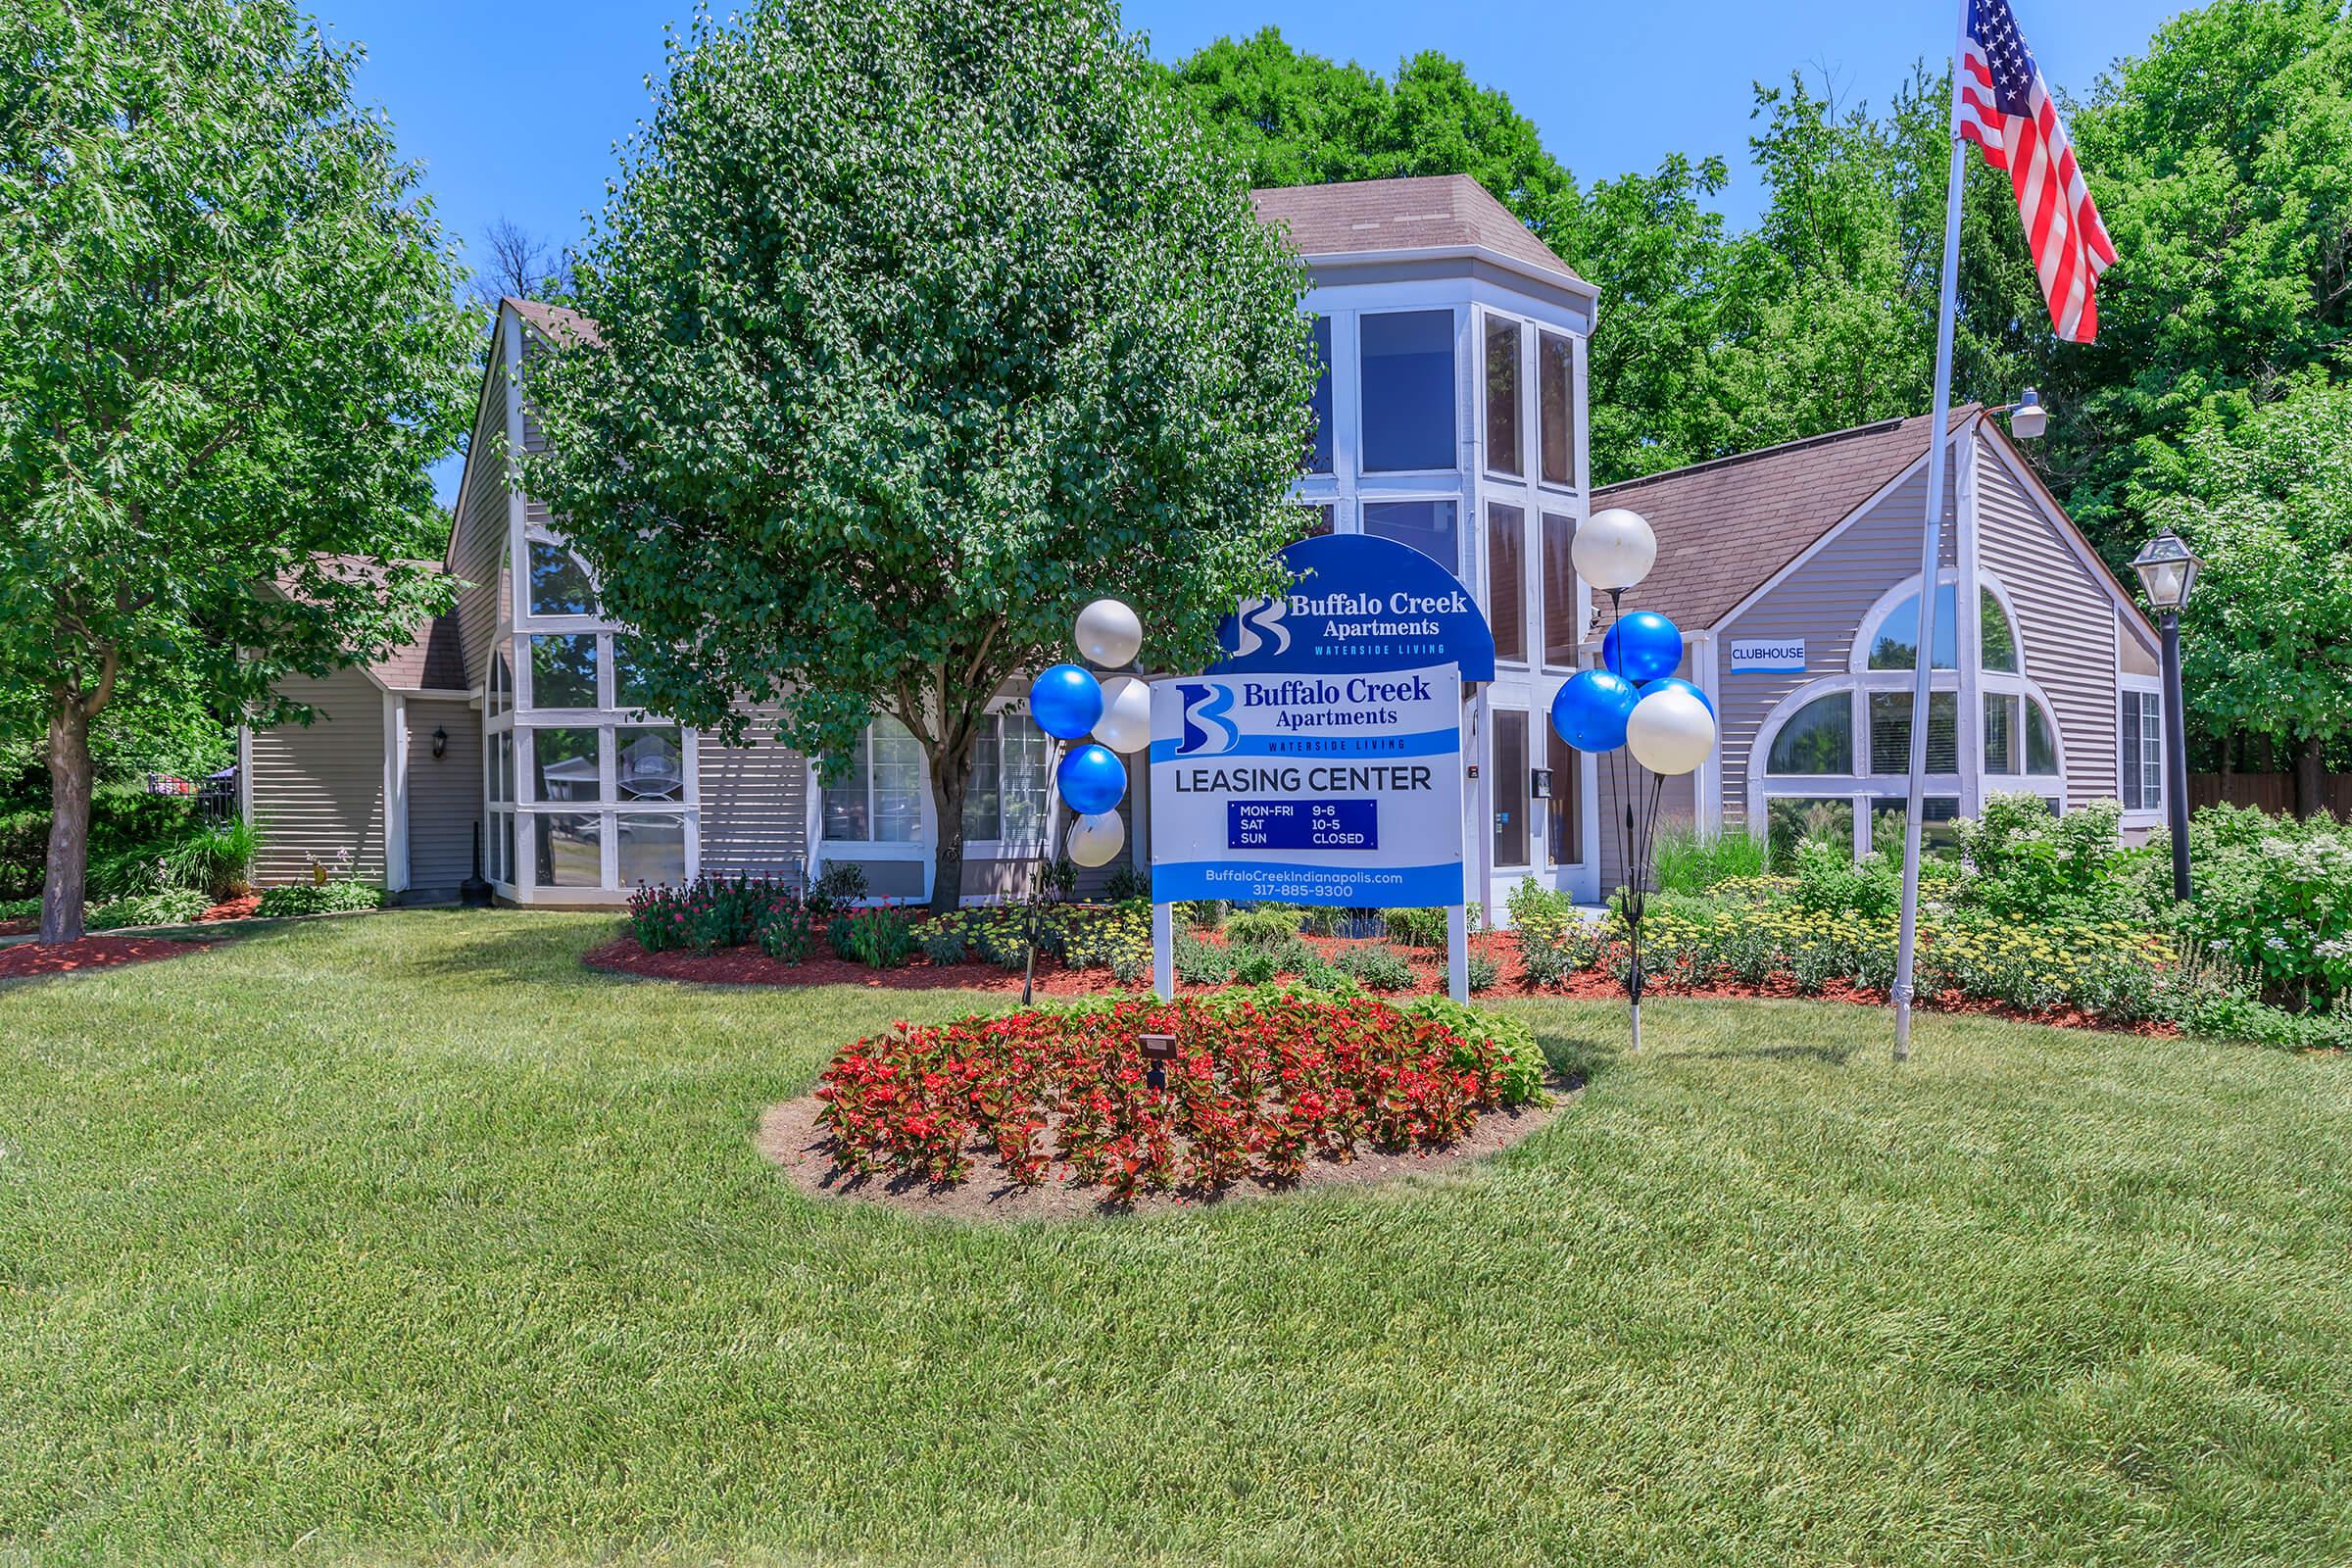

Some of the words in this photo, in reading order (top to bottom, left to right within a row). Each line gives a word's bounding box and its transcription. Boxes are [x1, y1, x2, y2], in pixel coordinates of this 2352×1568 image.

[1291, 594, 1382, 616] Buffalo
[1390, 591, 1468, 614] Creek
[1323, 620, 1440, 640] Apartments
[1315, 645, 1390, 656] WATERSIDE
[1398, 644, 1445, 655] LIVING
[1733, 648, 1804, 659] CLUBHOUSE
[1243, 681, 1340, 708] Buffalo
[1347, 675, 1432, 703] Creek
[1276, 707, 1397, 731] Apartments
[1269, 740, 1347, 753] WATERSIDE
[1356, 738, 1404, 751] LIVING
[1176, 768, 1300, 793] LEASING
[1308, 765, 1432, 792] CENTER
[1240, 805, 1294, 816] MON-FRI
[1312, 805, 1336, 816] 9-6
[1240, 818, 1264, 831] SAT
[1312, 818, 1341, 830] 10-5
[1240, 833, 1267, 845] SUN
[1312, 833, 1364, 845] CLOSED
[1205, 869, 1402, 885] BuffaloCreekIndianapolis.com
[1252, 884, 1353, 898] 317-885-9300
